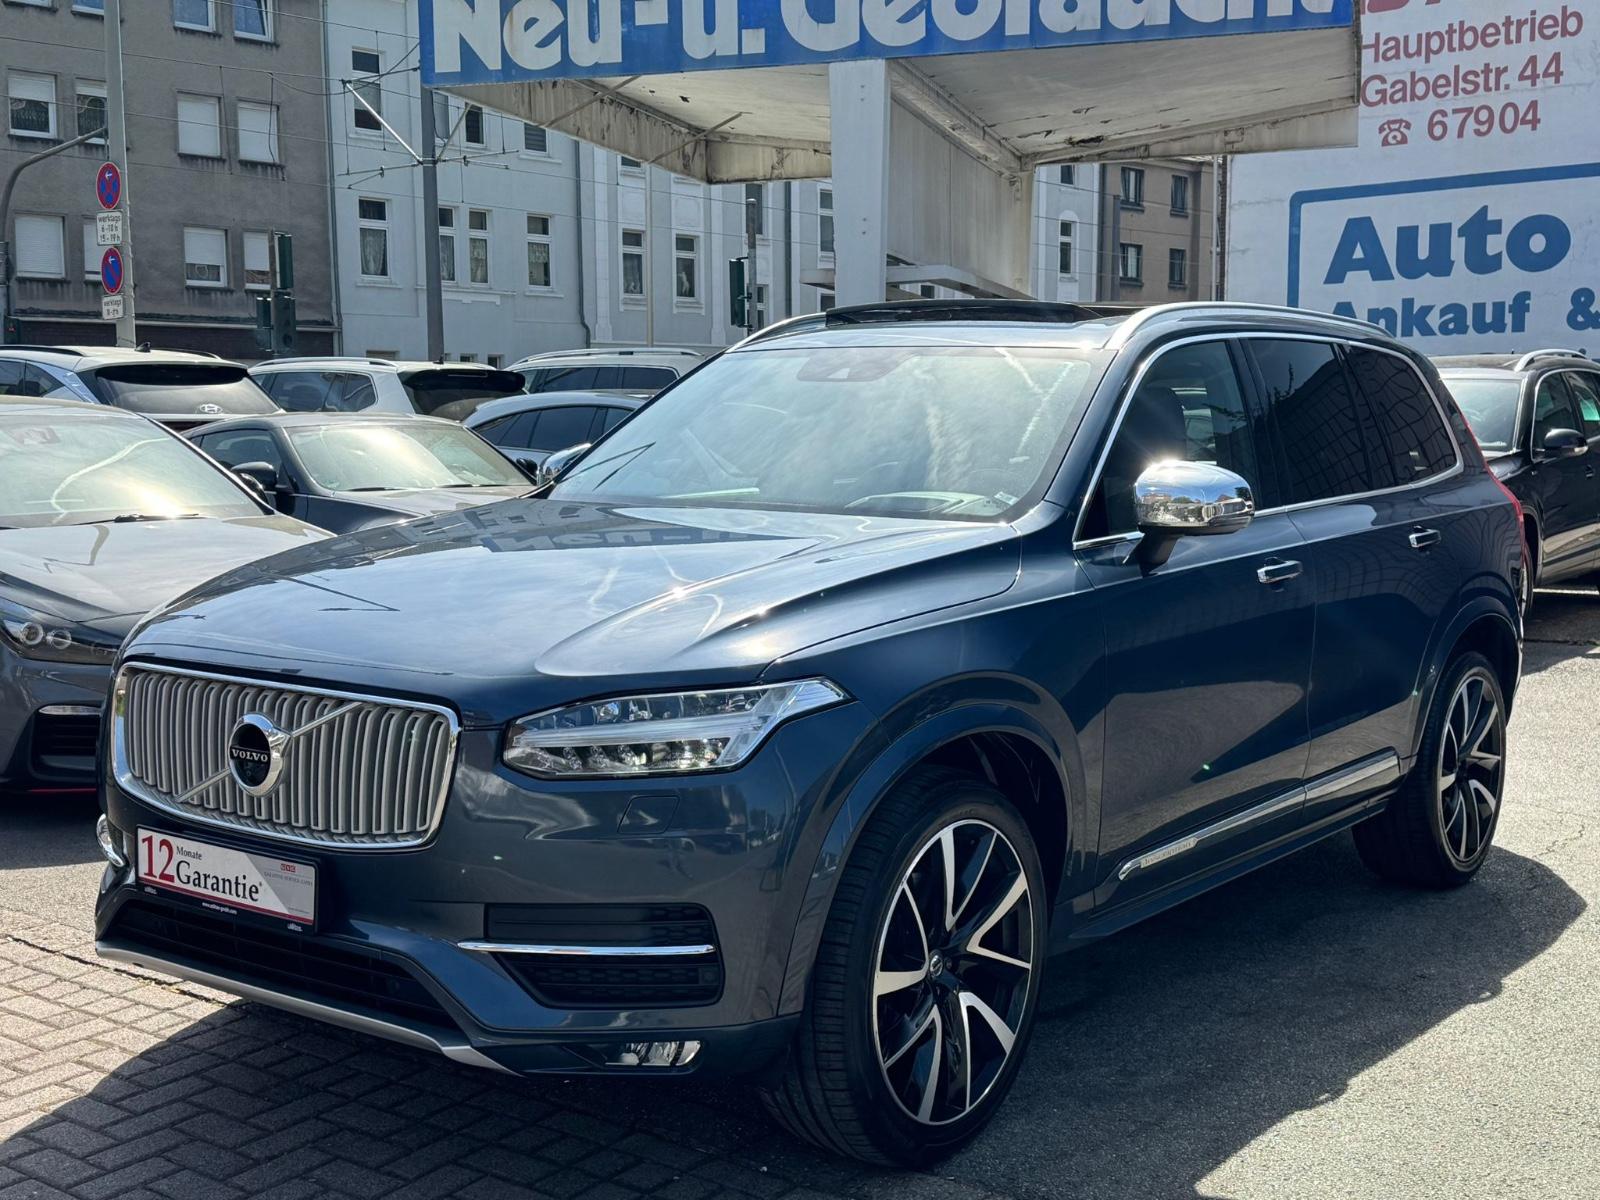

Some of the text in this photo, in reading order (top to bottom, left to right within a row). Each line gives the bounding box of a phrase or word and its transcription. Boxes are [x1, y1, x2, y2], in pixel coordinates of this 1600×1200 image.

[1360, 6, 1583, 63] Hauptbetrieb
[1361, 52, 1564, 107] Gabelstr. 44
[1323, 205, 1571, 284] Auto
[1566, 287, 1600, 331] &
[231, 749, 268, 762] VOLVO
[142, 835, 175, 883] 12
[176, 846, 202, 860] Monate
